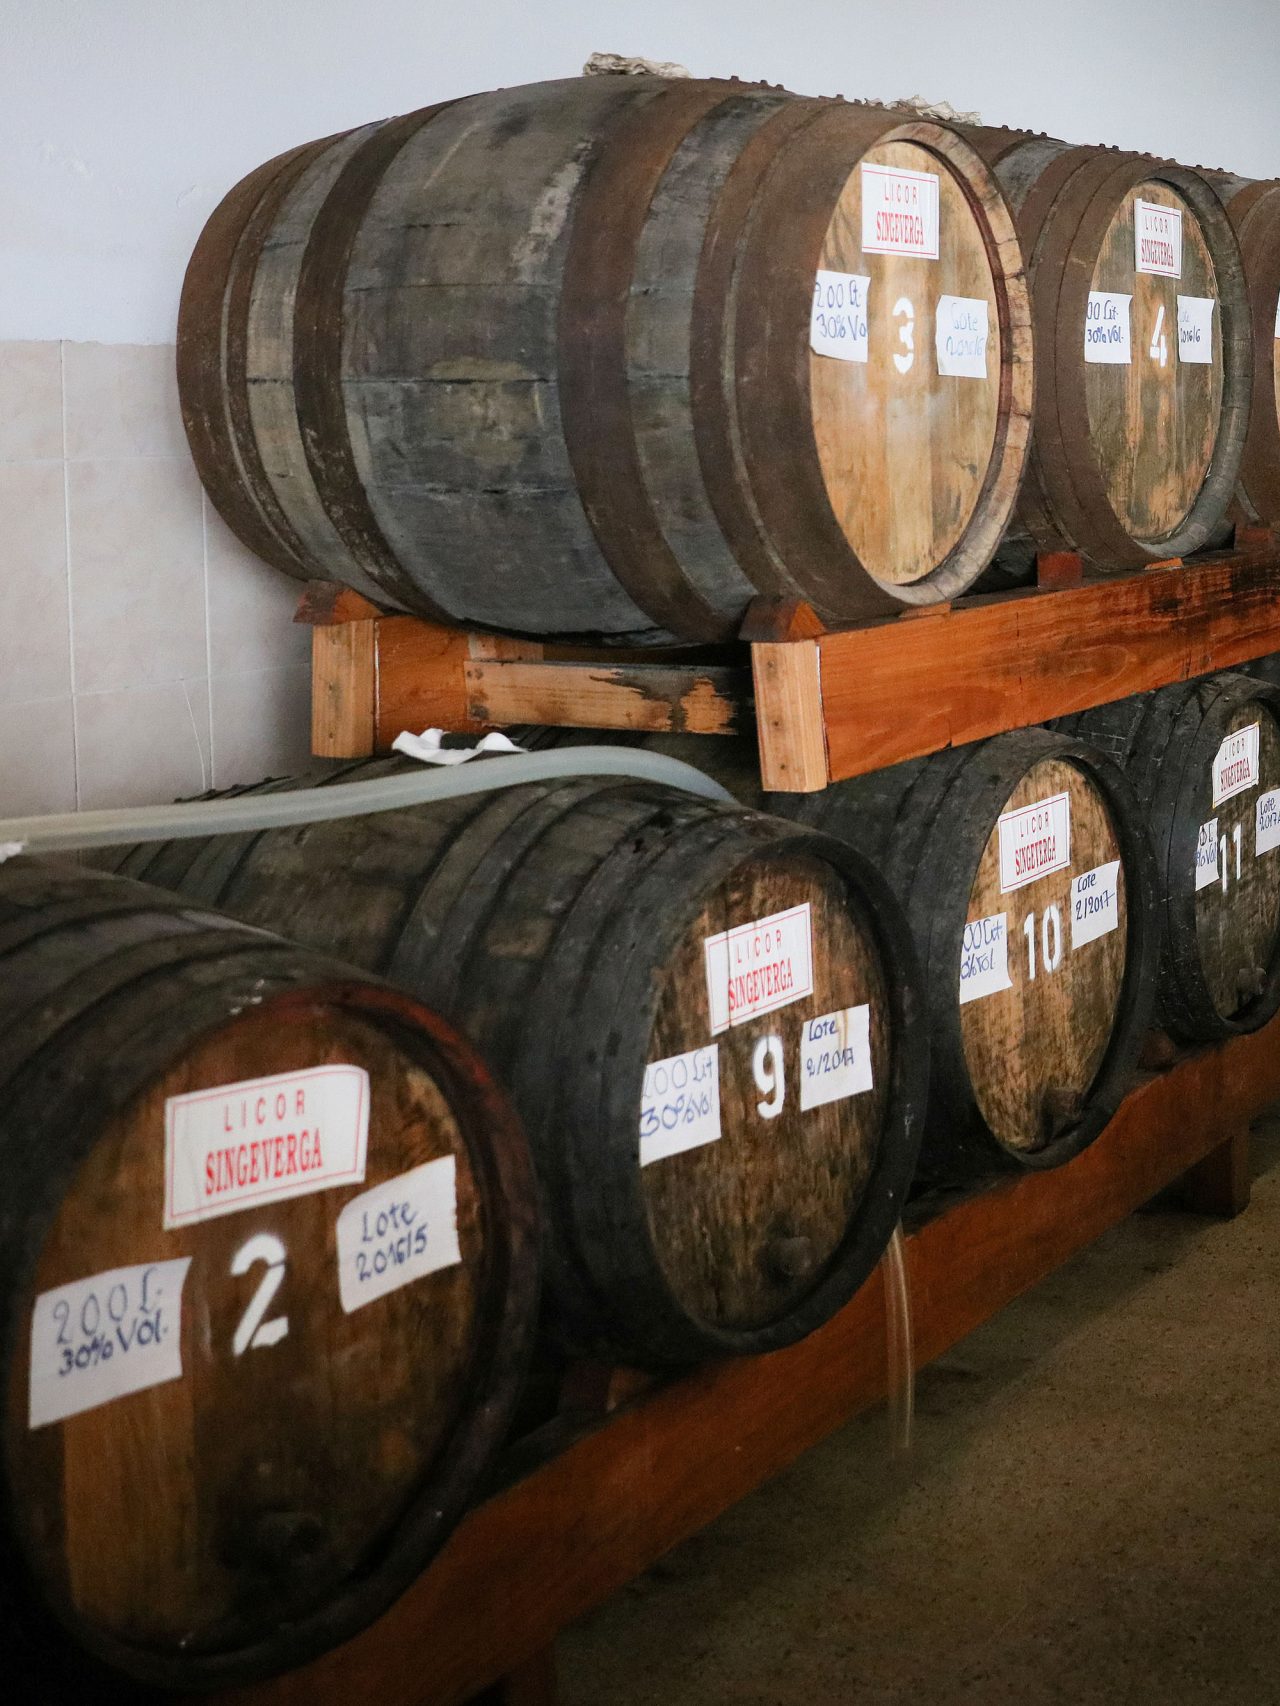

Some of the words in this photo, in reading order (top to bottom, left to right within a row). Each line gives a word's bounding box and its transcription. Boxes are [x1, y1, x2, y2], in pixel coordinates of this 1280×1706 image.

[884, 183, 918, 205] LICOR
[876, 211, 924, 245] SINGEVERGA
[1145, 215, 1168, 235] LICOR
[1141, 238, 1174, 267] SINGEVERGA
[893, 297, 914, 375] 3
[1149, 304, 1168, 368] 4
[1020, 811, 1049, 838] LICOR
[1015, 835, 1057, 876] SINGEVERGA
[1219, 822, 1242, 894] 11
[735, 929, 782, 964] LICOR
[1023, 903, 1063, 982] 10
[727, 957, 794, 1012] SINGEVERGA
[808, 1017, 839, 1042] Lote
[752, 1035, 785, 1120] 9
[223, 1088, 305, 1133] LICOR
[205, 1128, 323, 1196] SINGEVERGA
[362, 1200, 418, 1243] Lote
[53, 1283, 129, 1345] 200
[230, 1232, 289, 1357] 2
[58, 1332, 114, 1377] 30%
